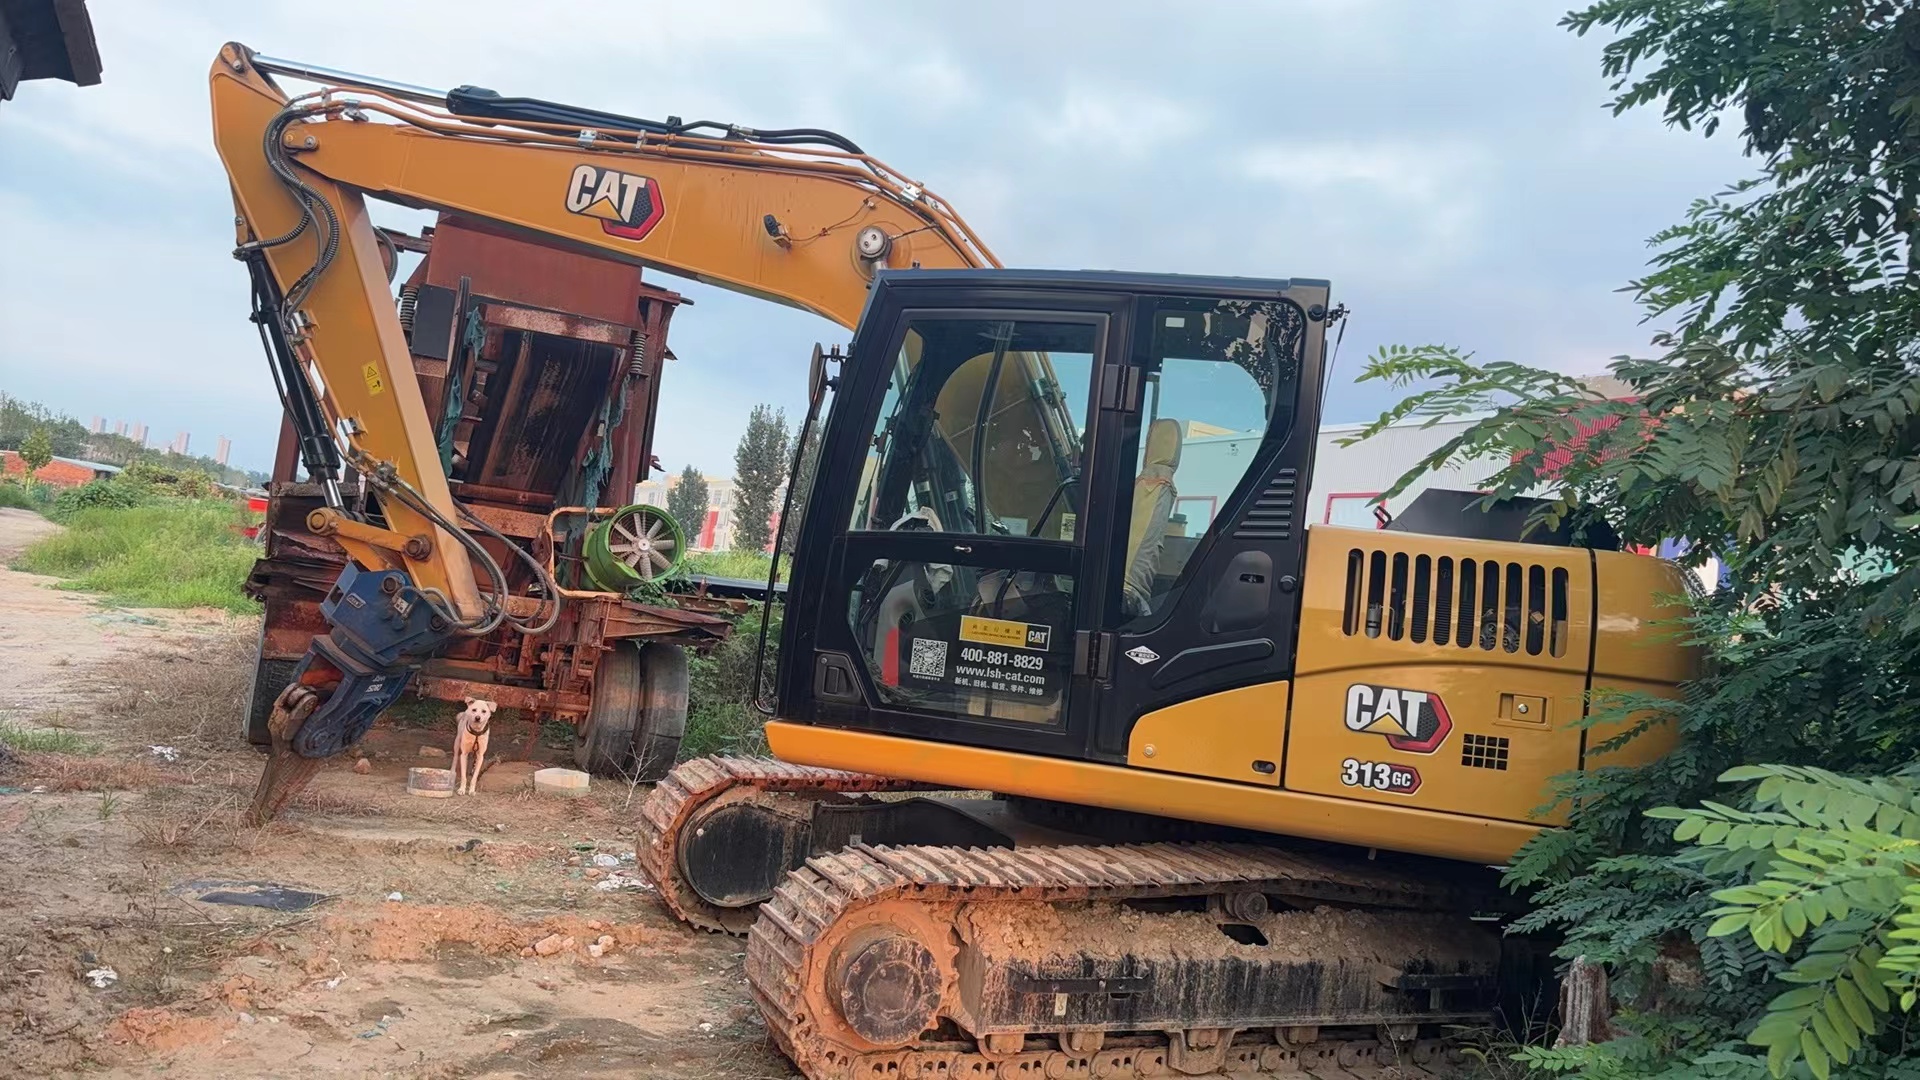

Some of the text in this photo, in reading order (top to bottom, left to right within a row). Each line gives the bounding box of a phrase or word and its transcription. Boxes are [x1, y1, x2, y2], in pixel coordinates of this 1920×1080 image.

[566, 165, 647, 223] CAT
[1028, 630, 1047, 644] CAT
[960, 647, 1044, 671] 400-881-8829
[956, 665, 1046, 685] www.lsh-cat.com
[1345, 684, 1428, 738] CAT
